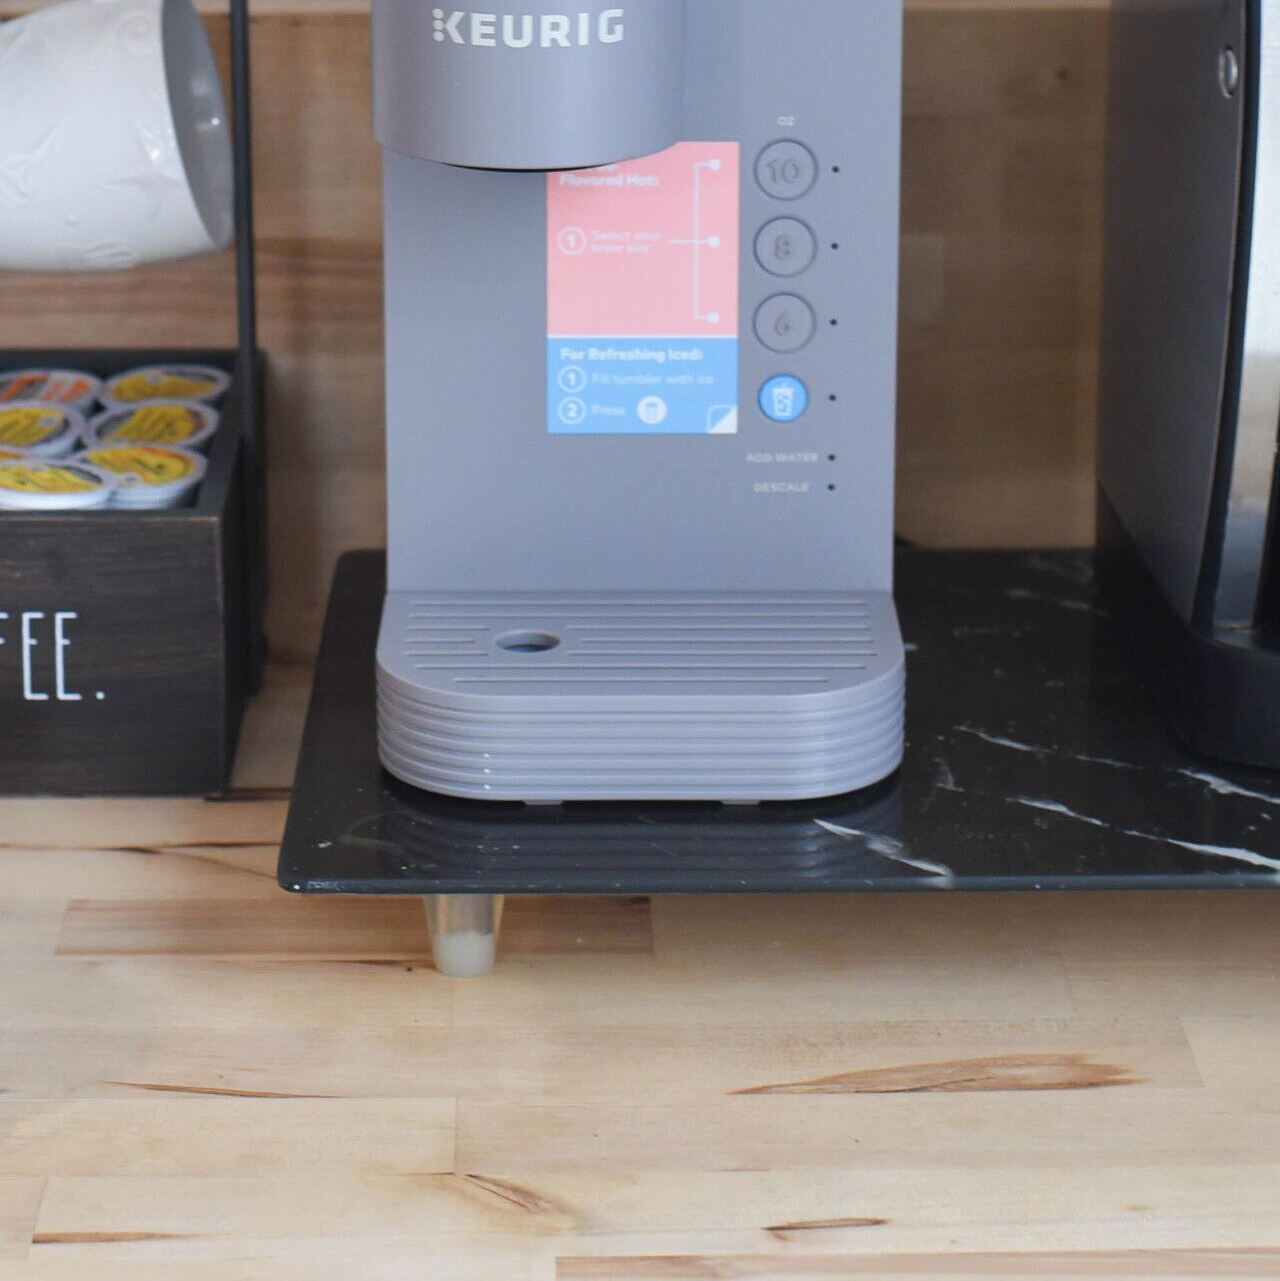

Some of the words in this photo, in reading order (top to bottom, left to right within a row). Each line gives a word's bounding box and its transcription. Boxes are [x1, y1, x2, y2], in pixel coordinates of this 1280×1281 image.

[432, 8, 625, 48] KEURIG
[767, 157, 800, 184] 10
[773, 233, 793, 260] 8
[774, 308, 791, 336] 6
[559, 347, 586, 361] For
[587, 347, 666, 364] Refreshing
[753, 482, 809, 493] DESCALE
